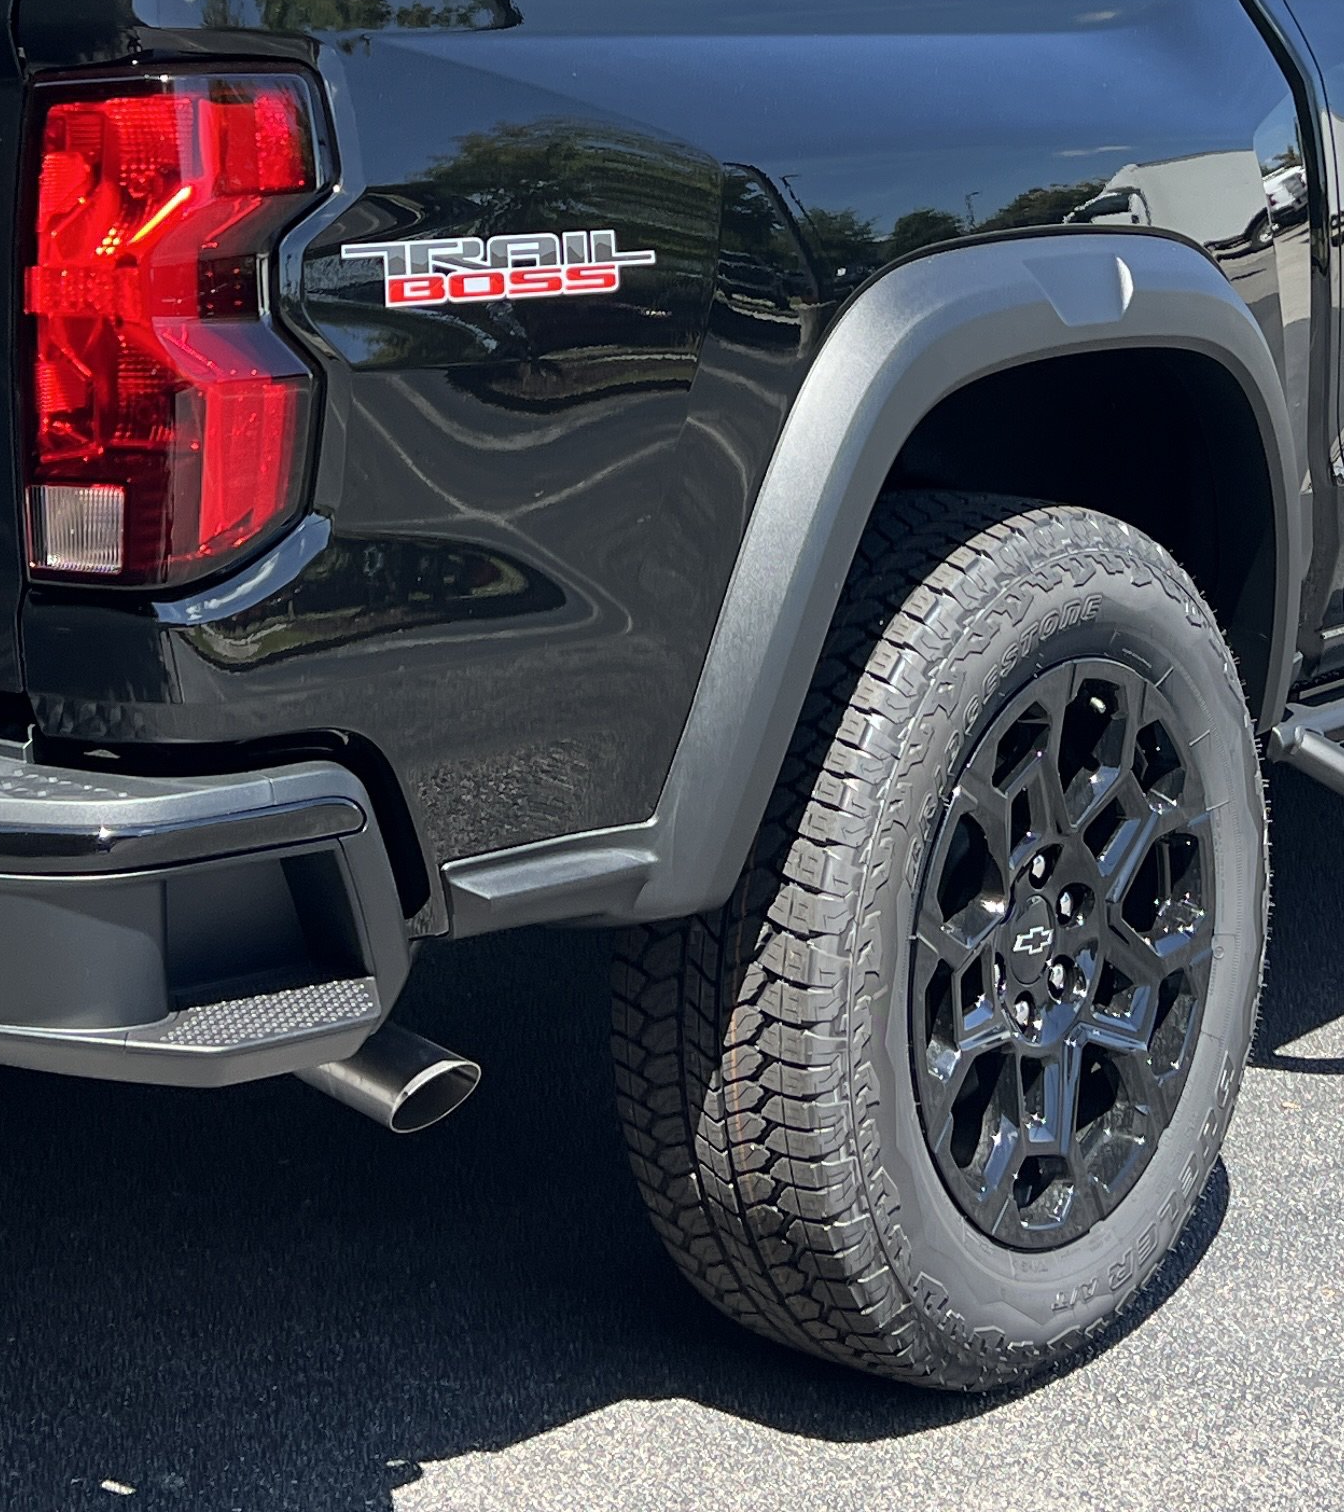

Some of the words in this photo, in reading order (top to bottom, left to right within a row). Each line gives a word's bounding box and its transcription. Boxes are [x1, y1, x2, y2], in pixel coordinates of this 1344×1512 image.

[341, 229, 655, 276] TRAIL
[385, 264, 619, 308] BOSS
[905, 595, 1102, 890] BRIDGESTONE
